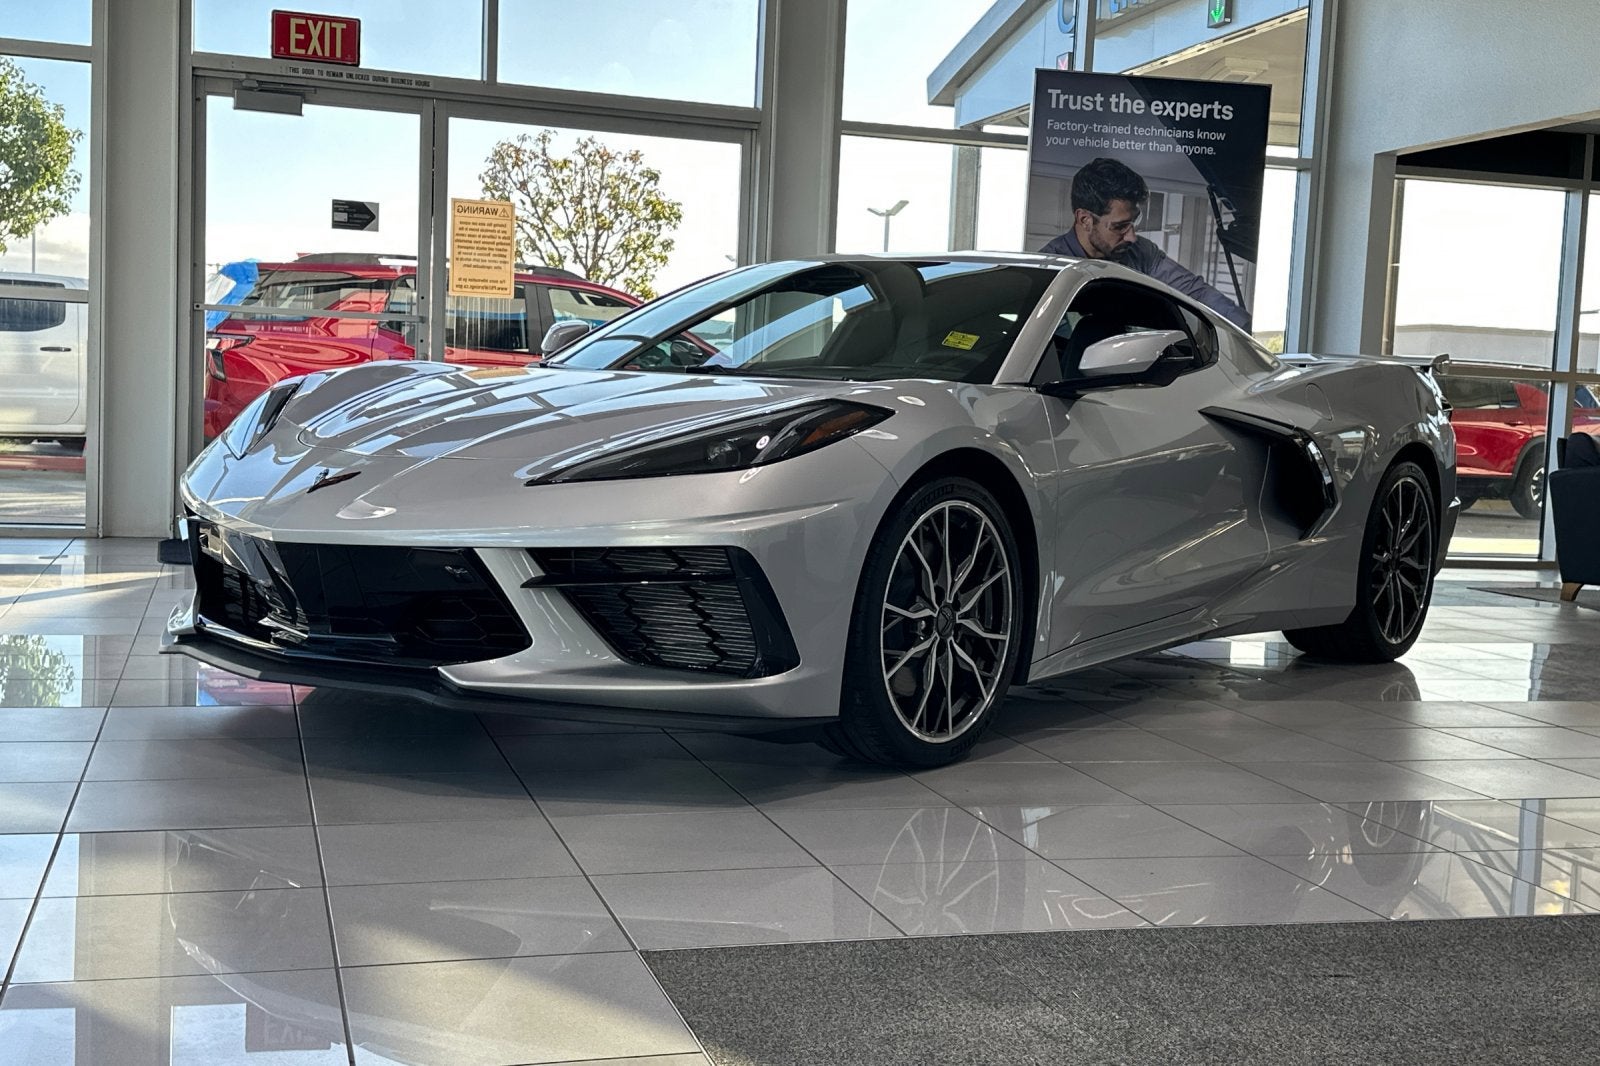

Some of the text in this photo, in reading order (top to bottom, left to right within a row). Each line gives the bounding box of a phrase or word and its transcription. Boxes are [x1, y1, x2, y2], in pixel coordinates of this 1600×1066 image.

[290, 17, 347, 58] EXIT
[302, 67, 314, 75] DOOR
[346, 72, 370, 80] UNLOCKED
[391, 77, 413, 85] BUSINESS
[1047, 88, 1234, 121] Trust the experts
[1047, 119, 1226, 141] Factory-trained technicians know
[1045, 135, 1216, 156] your vehicle better than anyone.
